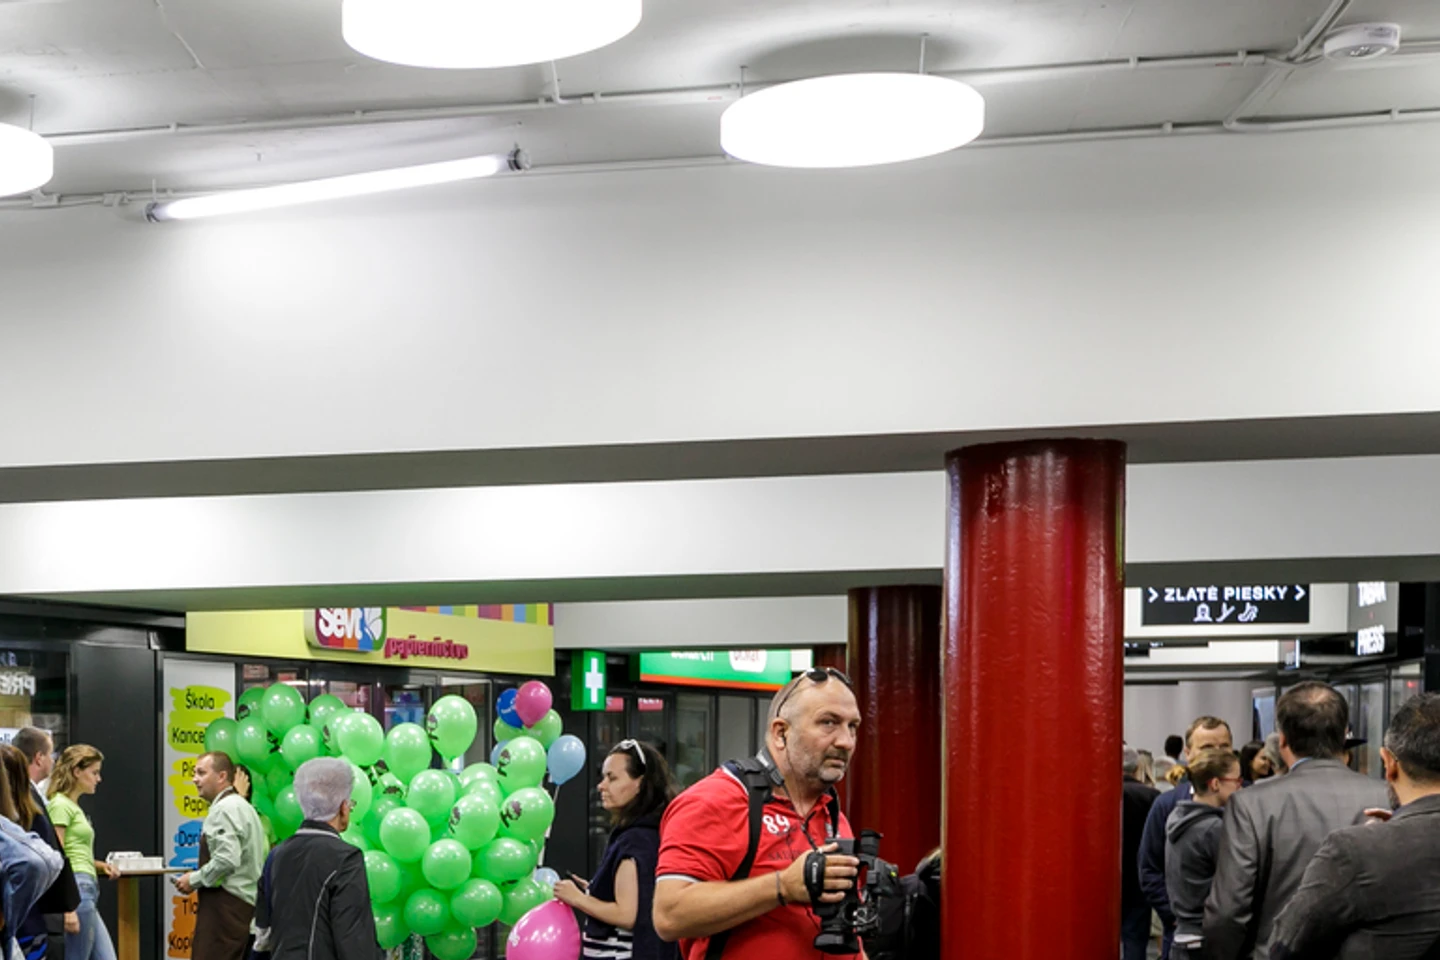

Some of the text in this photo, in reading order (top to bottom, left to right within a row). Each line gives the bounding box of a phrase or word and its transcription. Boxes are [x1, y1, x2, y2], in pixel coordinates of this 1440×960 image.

[1224, 586, 1288, 601] PIESKY
[384, 634, 469, 660] papiernictvo
[185, 689, 215, 710] Škola
[172, 727, 205, 744] Kance
[762, 813, 791, 835] 89
[167, 934, 194, 953] Kop
